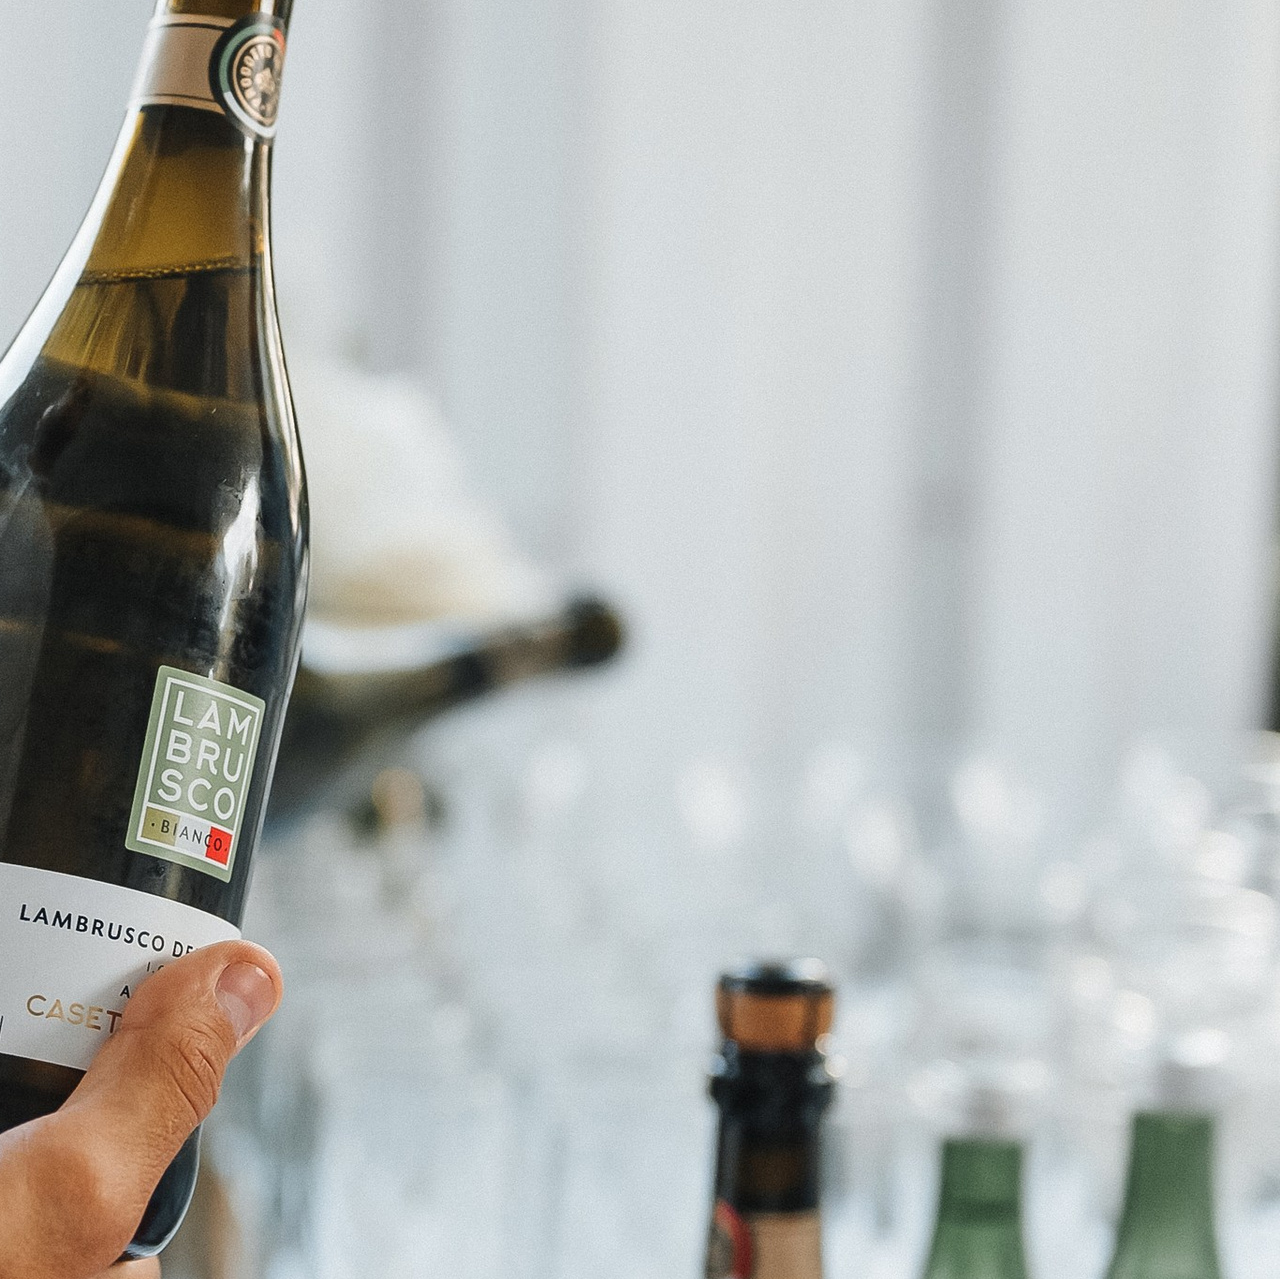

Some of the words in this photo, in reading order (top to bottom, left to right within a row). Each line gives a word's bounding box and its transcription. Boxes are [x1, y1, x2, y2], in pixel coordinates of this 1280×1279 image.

[173, 690, 252, 746] LAM
[165, 728, 244, 782] BRU
[157, 768, 235, 820] SCO
[160, 820, 223, 851] BIANCO
[19, 903, 165, 952] LAMBRUSCO
